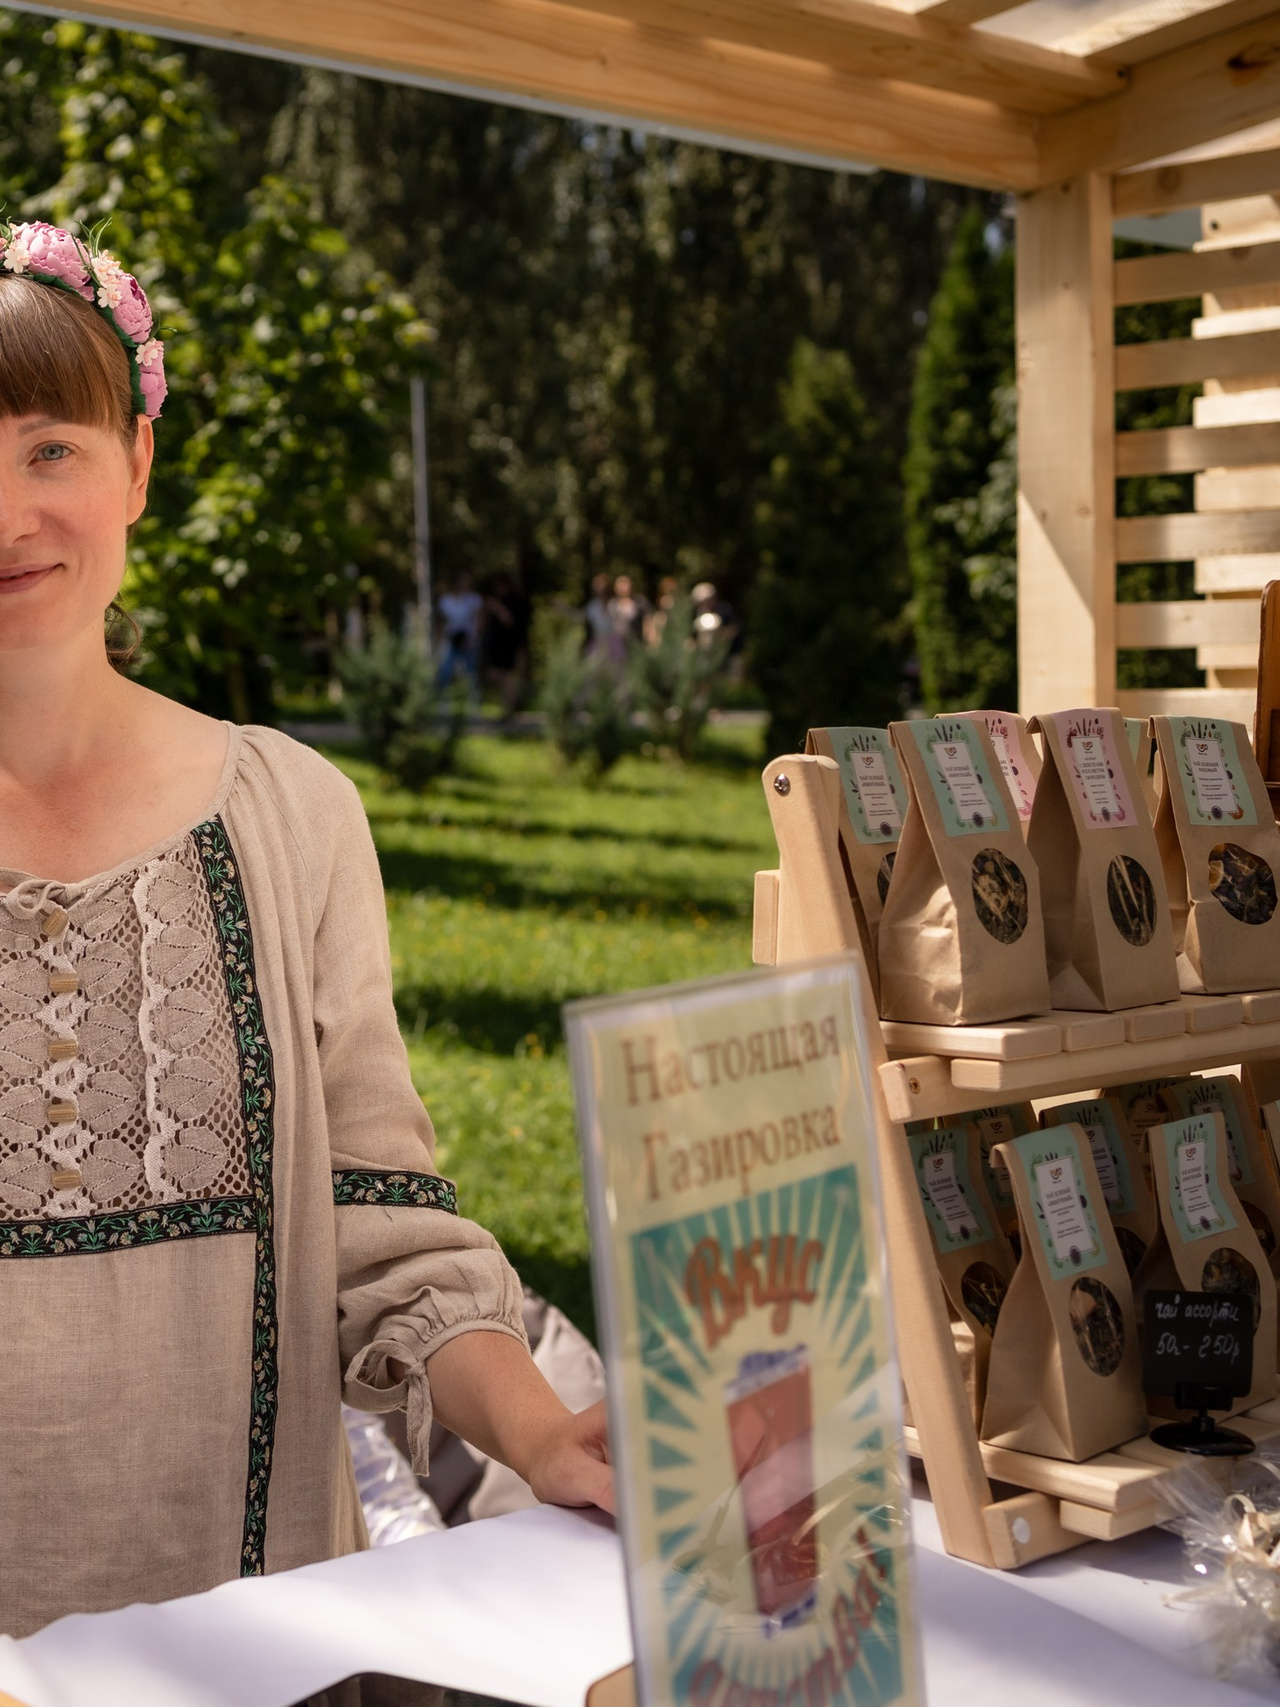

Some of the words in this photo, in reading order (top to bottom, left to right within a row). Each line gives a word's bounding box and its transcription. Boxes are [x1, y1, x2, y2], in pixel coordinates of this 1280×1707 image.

[621, 1013, 841, 1108] Настоящая
[641, 1104, 842, 1202] Газировка
[684, 1233, 825, 1352] Вкус
[1185, 1301, 1240, 1327] ассорти
